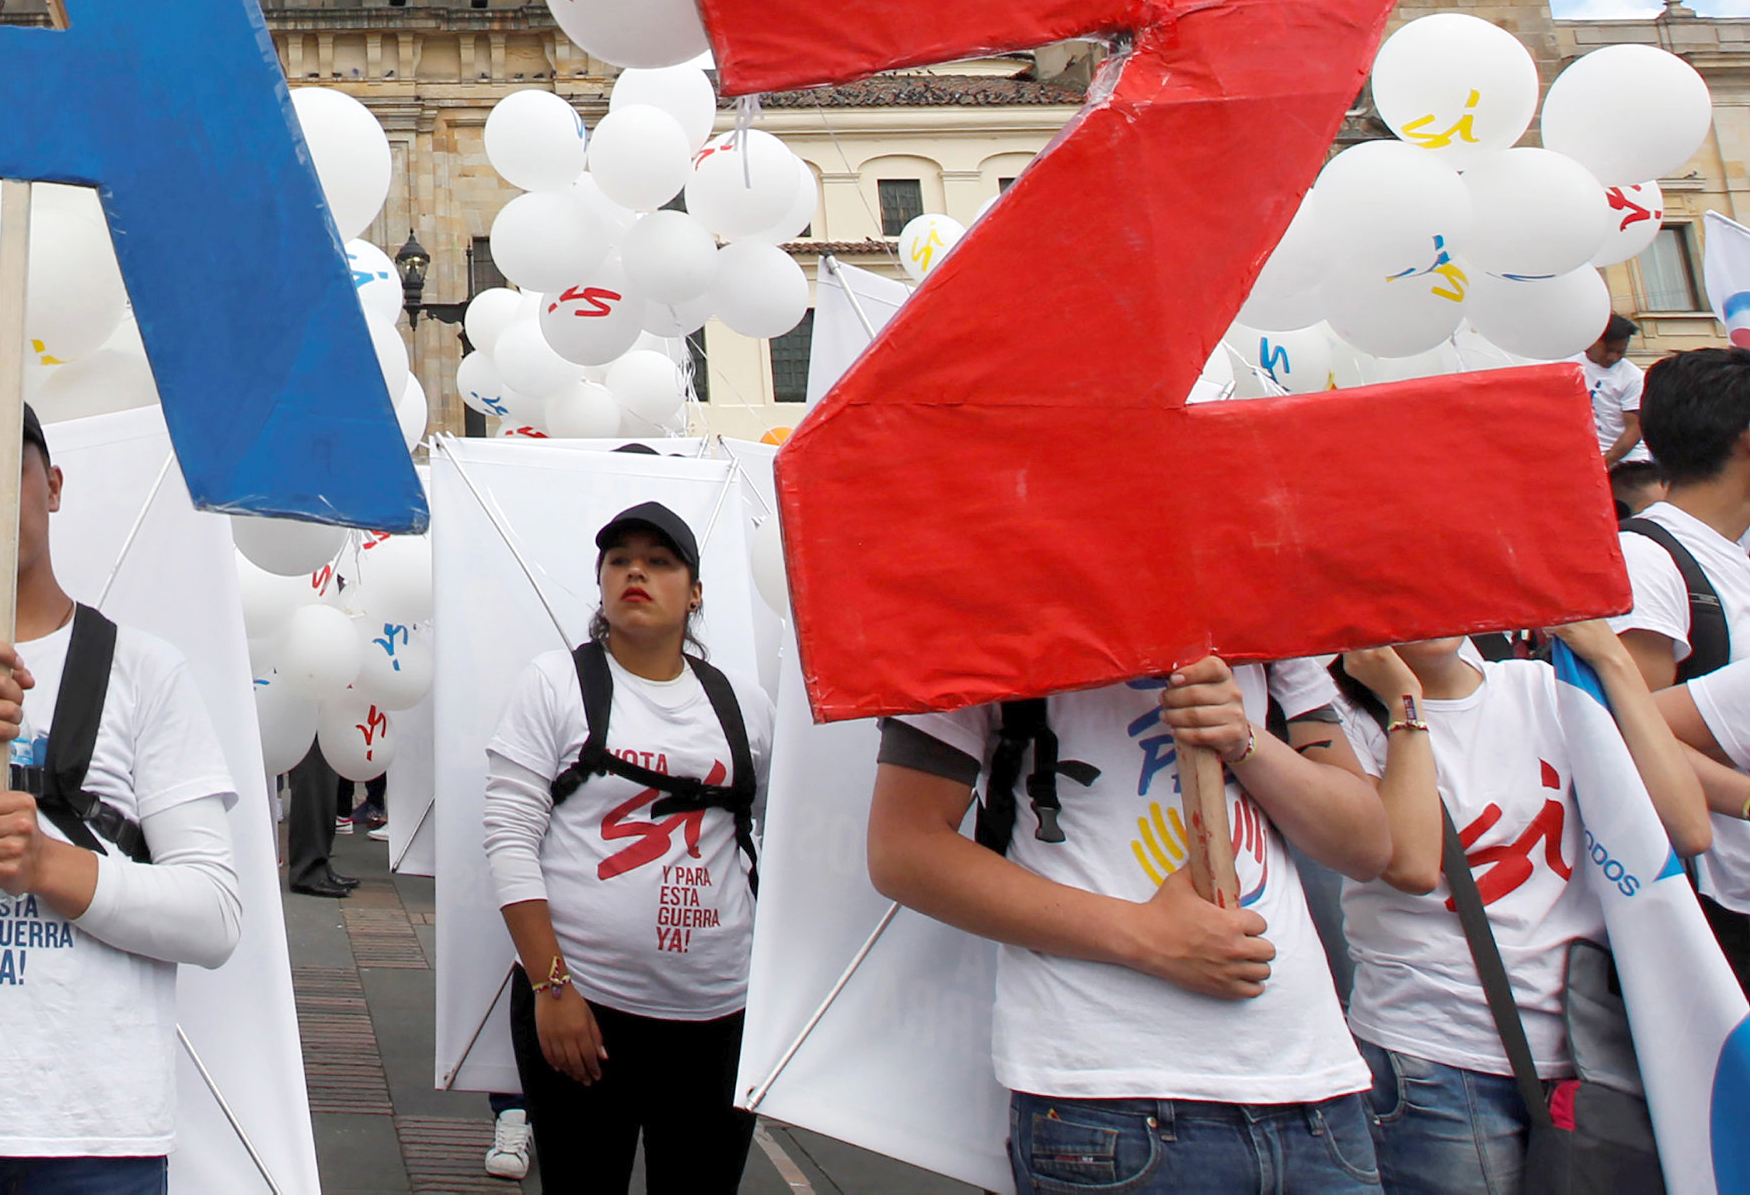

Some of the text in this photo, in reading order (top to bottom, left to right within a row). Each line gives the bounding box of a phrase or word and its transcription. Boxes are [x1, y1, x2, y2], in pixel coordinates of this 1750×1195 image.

[662, 865, 712, 887] Y PARA
[659, 886, 700, 907] ESTA
[658, 906, 721, 928] GUERRA
[656, 926, 691, 953] YA!
